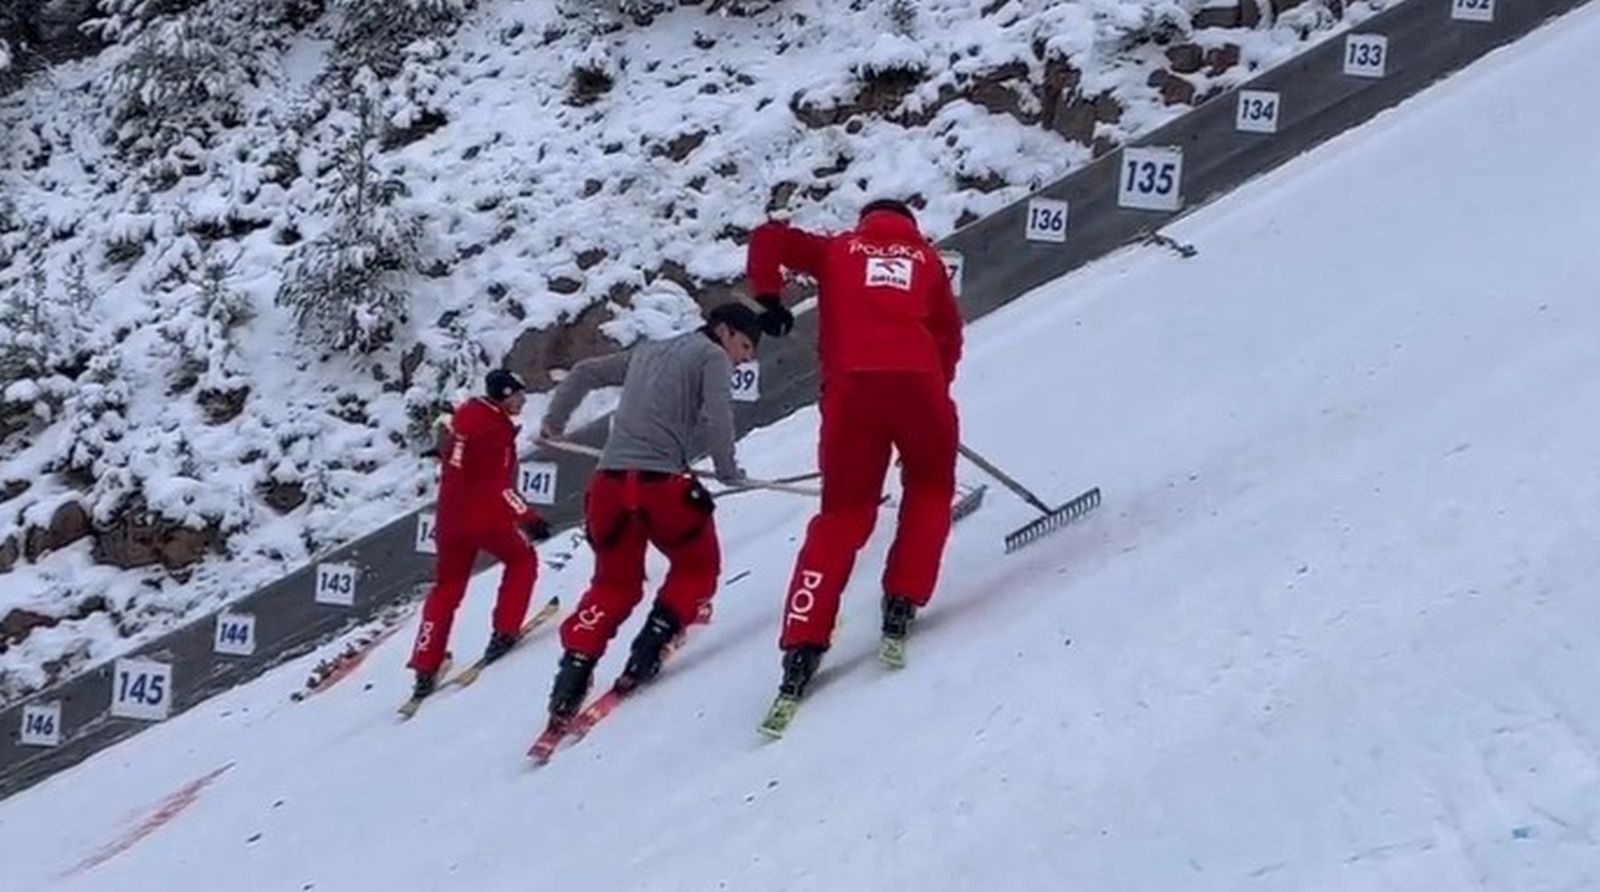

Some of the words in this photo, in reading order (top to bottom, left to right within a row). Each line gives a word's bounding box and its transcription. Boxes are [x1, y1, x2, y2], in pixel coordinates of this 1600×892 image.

[1349, 43, 1383, 66] 133
[1241, 99, 1276, 121] 134
[1125, 160, 1176, 195] 135
[1030, 208, 1063, 231] 136
[848, 239, 926, 264] POLSKA
[730, 369, 756, 391] 39
[522, 471, 551, 494] 141
[321, 572, 351, 592] 143
[786, 570, 824, 627] POL
[220, 622, 248, 645] 144
[119, 672, 166, 706] 145
[25, 713, 54, 736] 146
